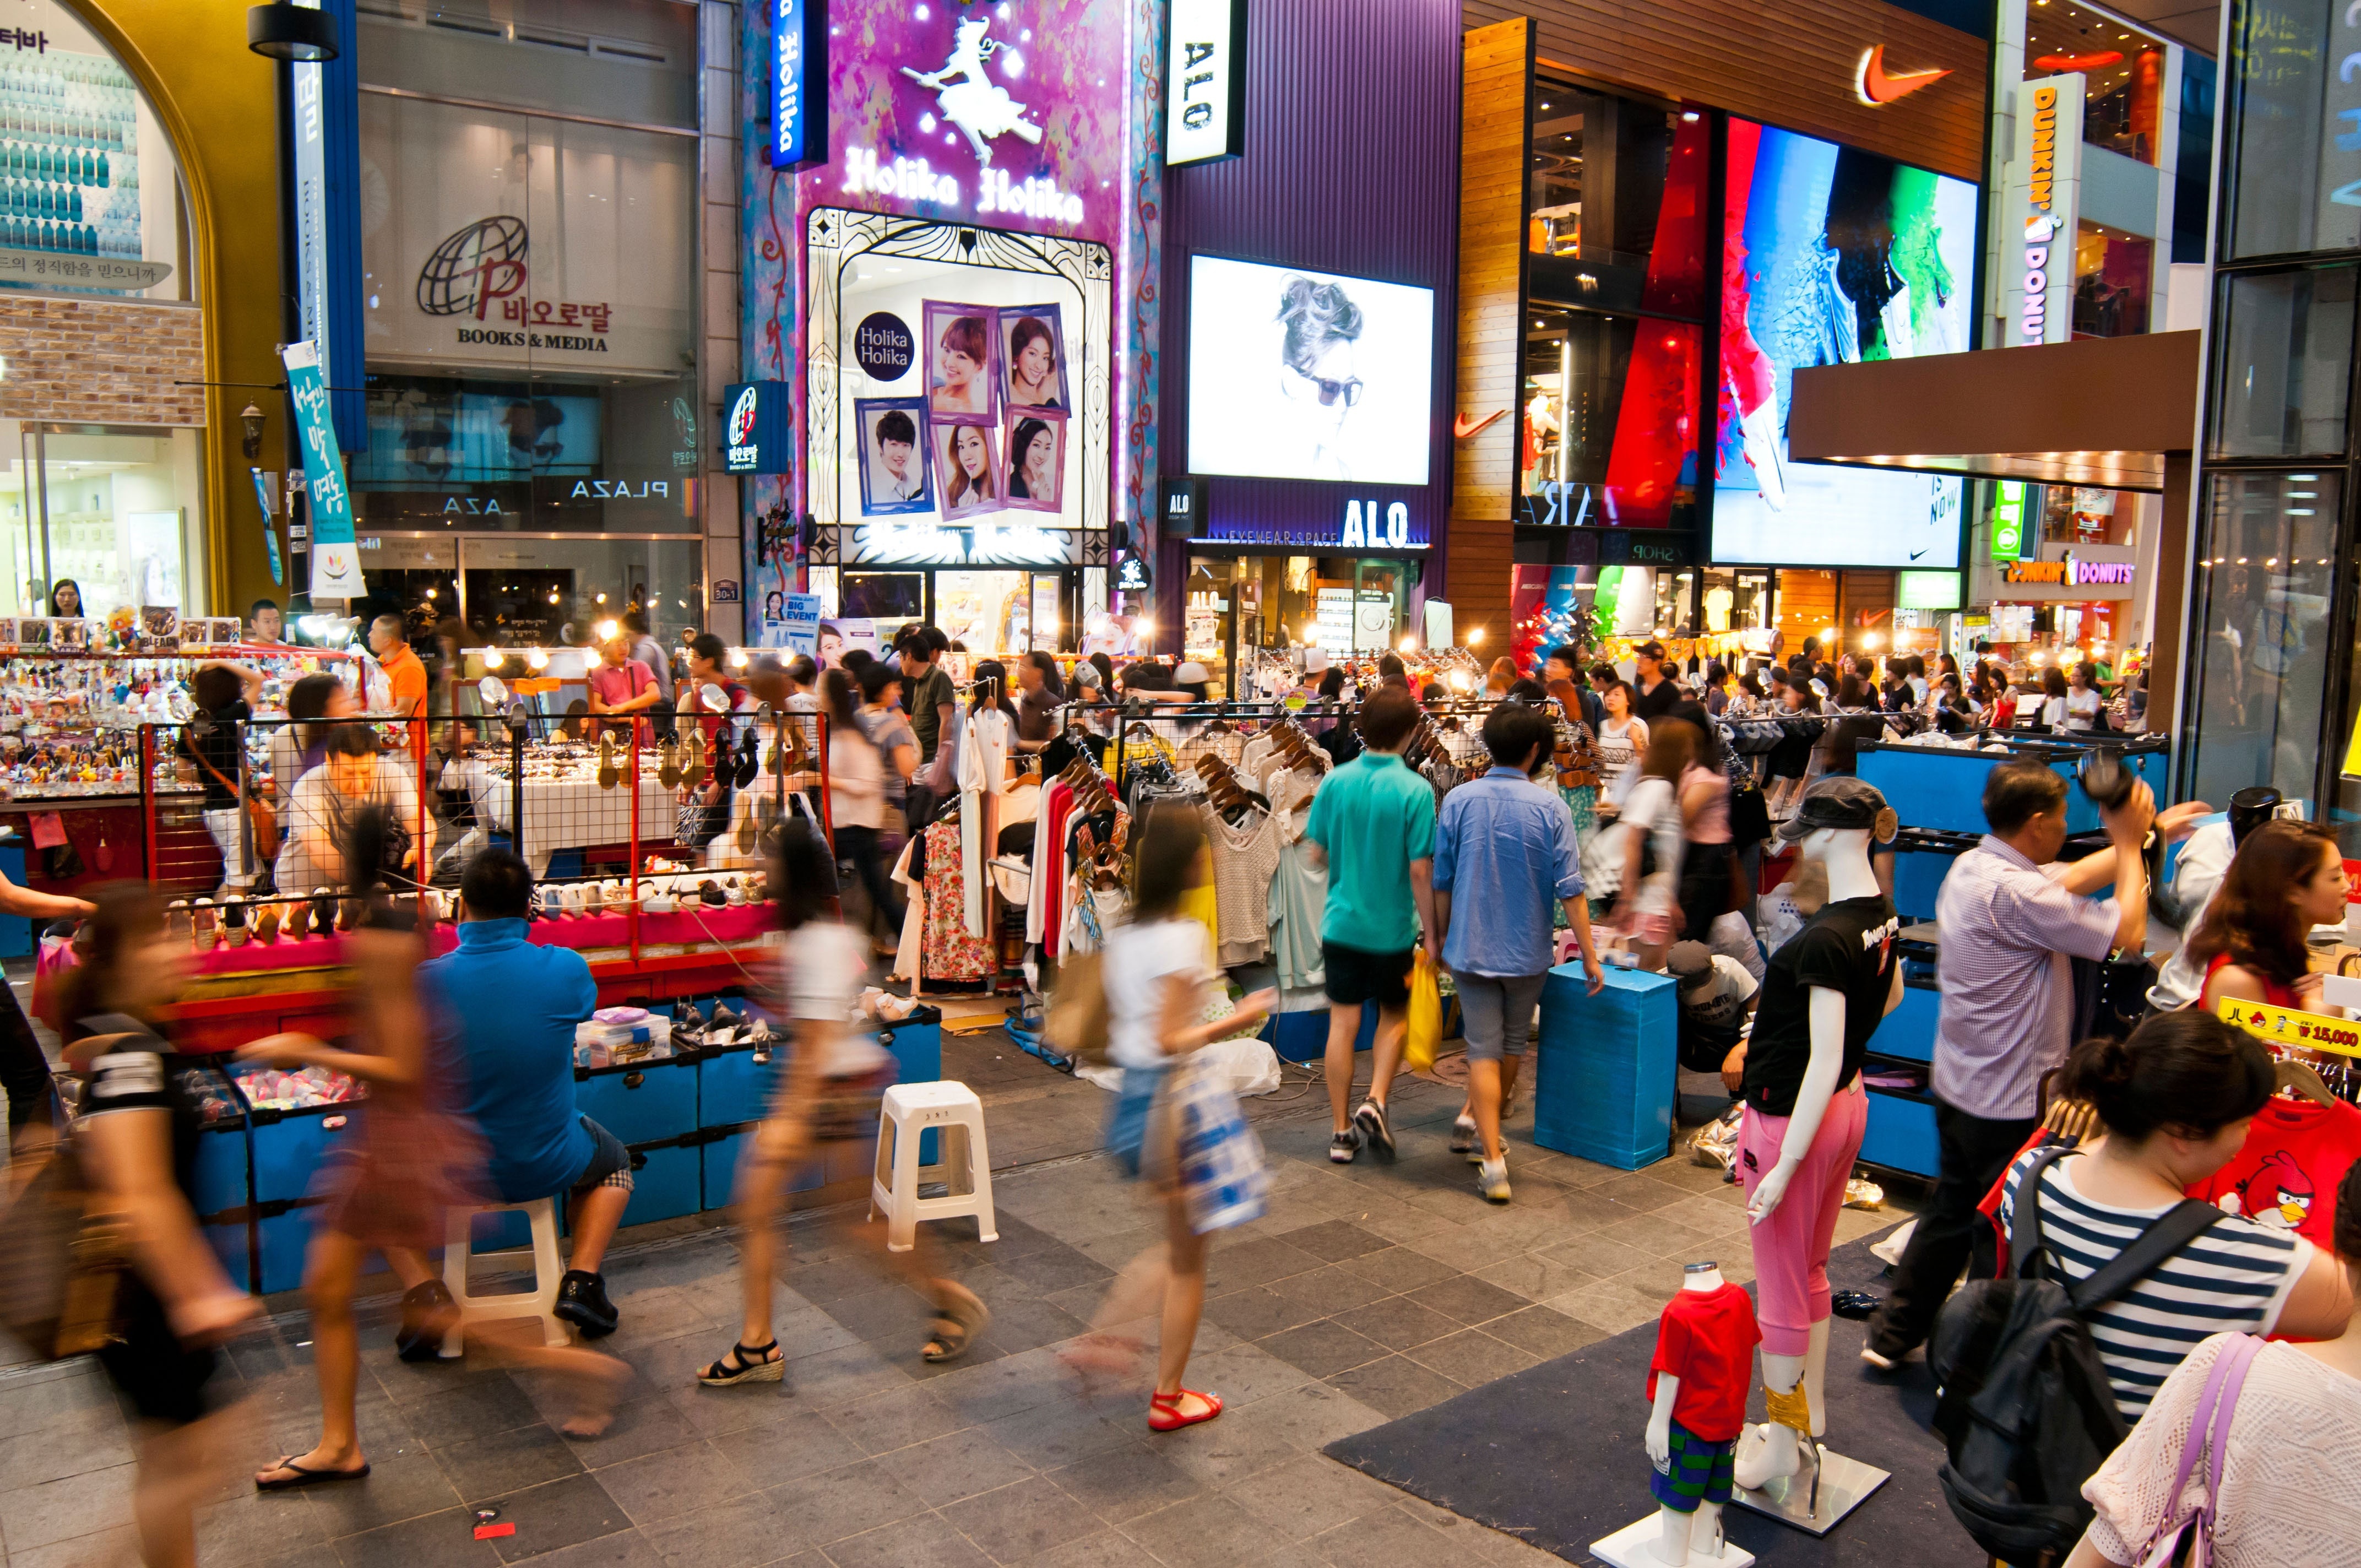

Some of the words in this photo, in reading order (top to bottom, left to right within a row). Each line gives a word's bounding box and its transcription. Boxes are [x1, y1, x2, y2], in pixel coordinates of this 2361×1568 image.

[779, 31, 799, 153] Holika
[1184, 42, 1214, 131] ALO
[2028, 87, 2056, 210] DUNKIN'
[842, 147, 959, 206] Holika
[977, 166, 1083, 223] Holika
[33, 259, 93, 277] 정직함을
[97, 264, 156, 282] 믿으니까
[502, 296, 612, 332] 바오로딸
[458, 328, 525, 347] BOOKS
[529, 333, 542, 347] &
[545, 334, 608, 352] MEDIA
[861, 327, 907, 347] Holika
[861, 346, 907, 366] Holika
[729, 444, 758, 464] 바오로딸
[1170, 495, 1189, 513] ALO
[1229, 530, 1290, 545] EYEWEAR
[1296, 531, 1337, 546] SPACE
[1342, 500, 1408, 548] ALO
[2079, 562, 2132, 584] DONUTS
[788, 601, 804, 611] BIG
[1191, 590, 1219, 610] ALO
[786, 611, 818, 621] EVENT
